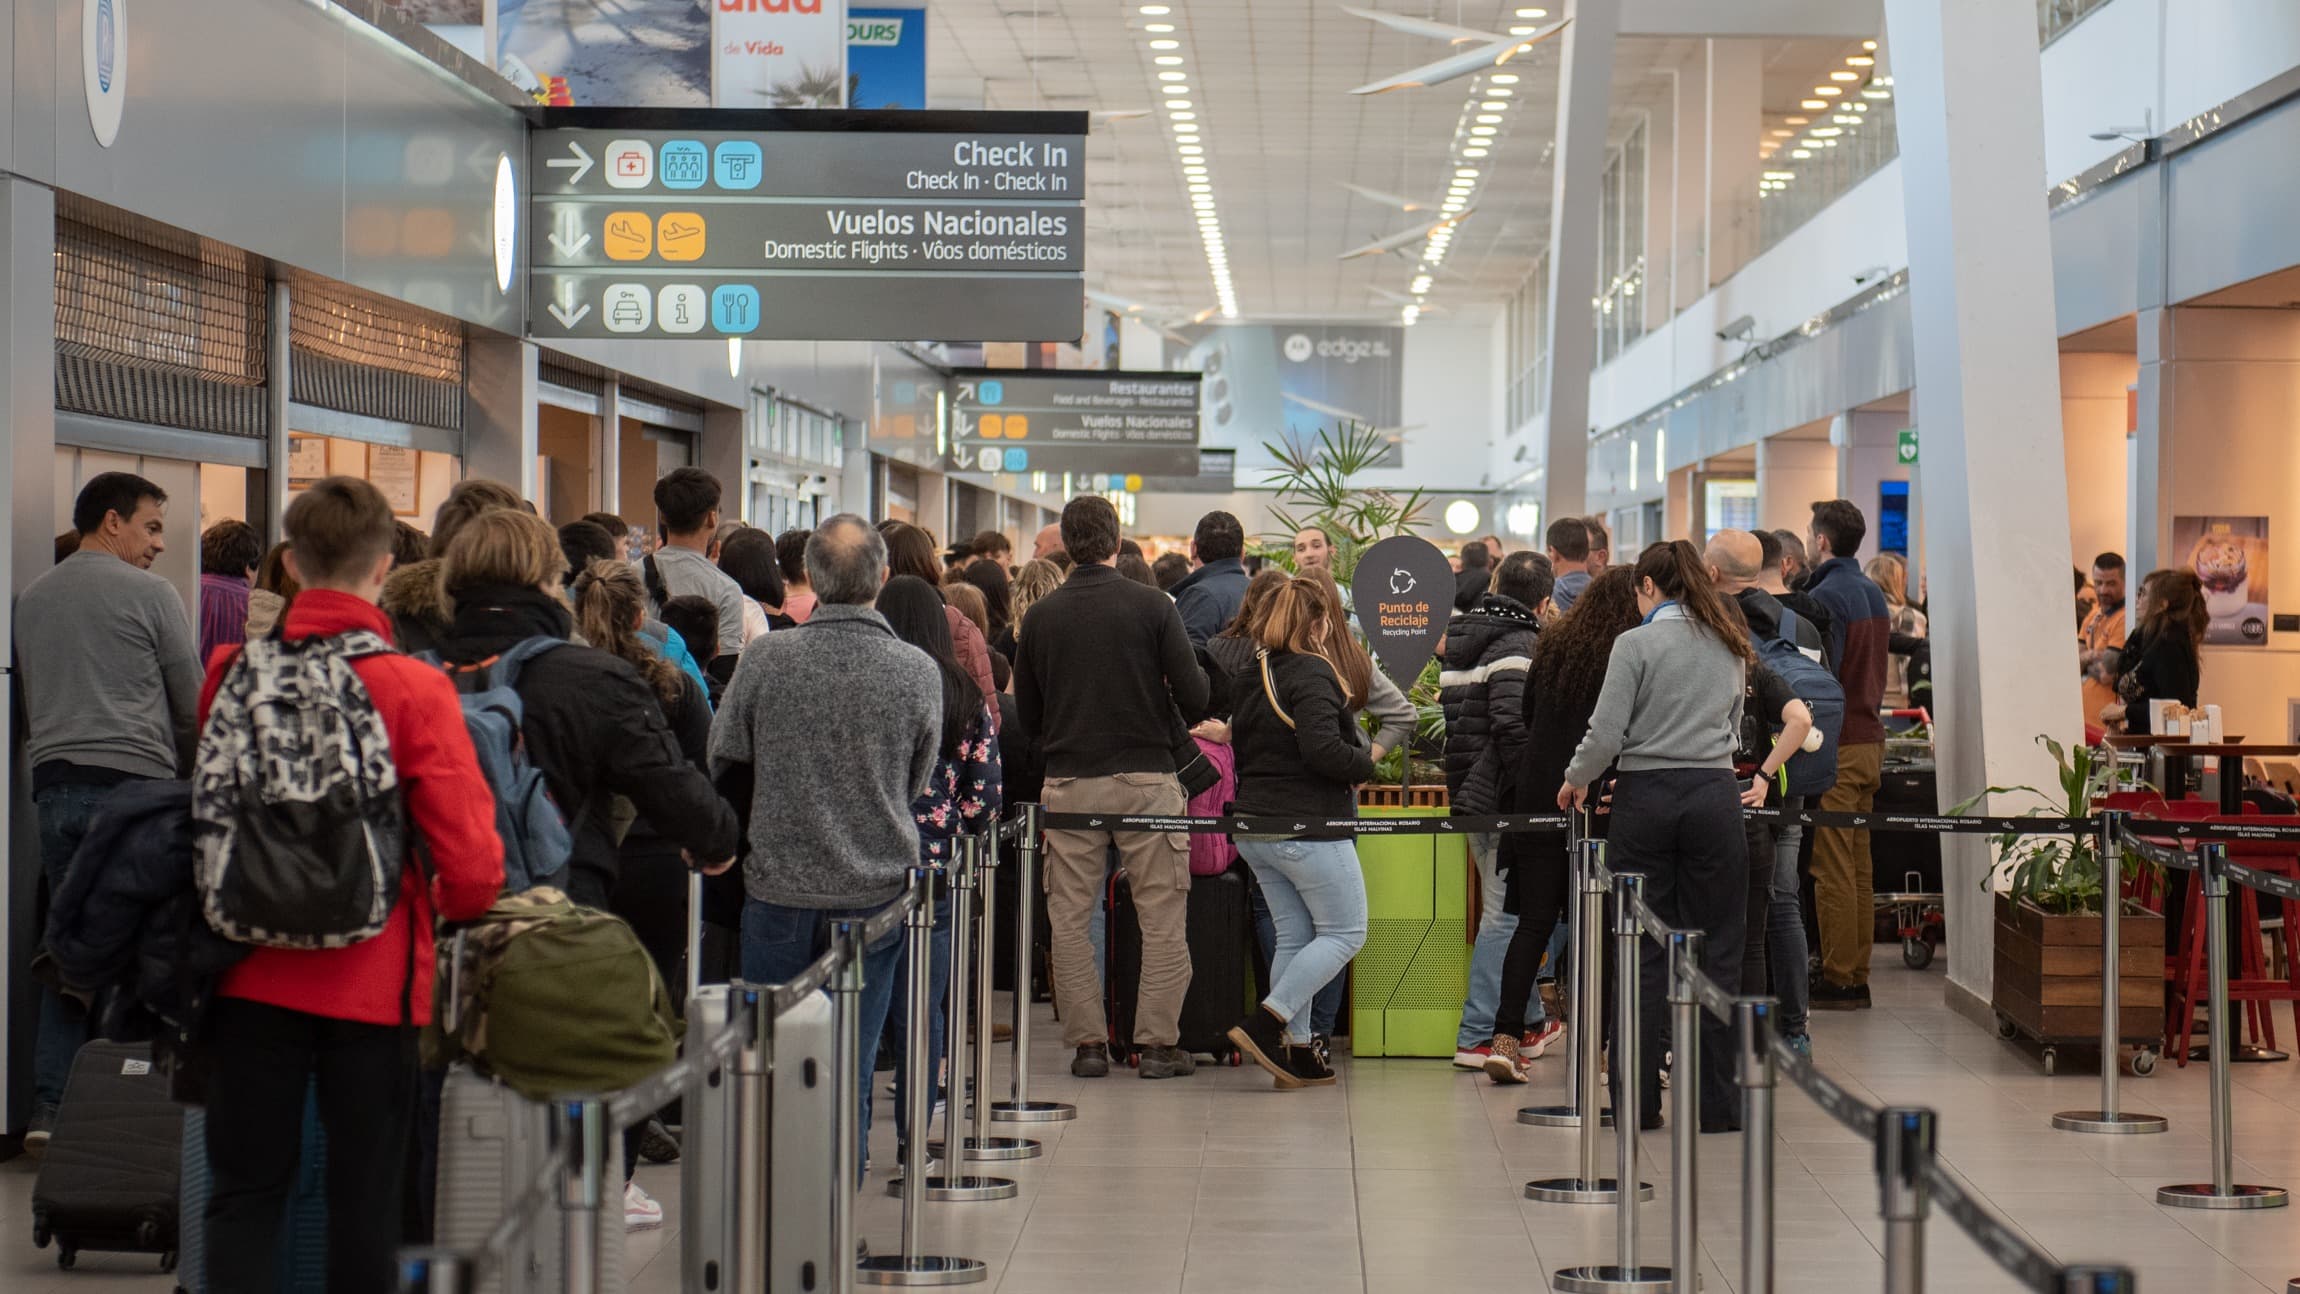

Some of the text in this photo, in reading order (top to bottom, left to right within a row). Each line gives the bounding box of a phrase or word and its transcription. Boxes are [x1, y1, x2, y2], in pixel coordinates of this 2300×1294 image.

[745, 41, 784, 56] Vida
[953, 140, 1068, 167] Check In
[906, 170, 1068, 191] Check In Check In
[827, 209, 1068, 236] Vuelos Nacionales
[764, 239, 1068, 264] Domestic Flights Vôos domésticos
[1317, 335, 1372, 364] edge
[1109, 381, 1195, 396] Restaurantes
[1081, 415, 1194, 429] Vuelos Nacionales
[1378, 601, 1430, 614] Punto de
[1380, 614, 1429, 628] Reciclaje
[1382, 628, 1427, 637] Recycling Point
